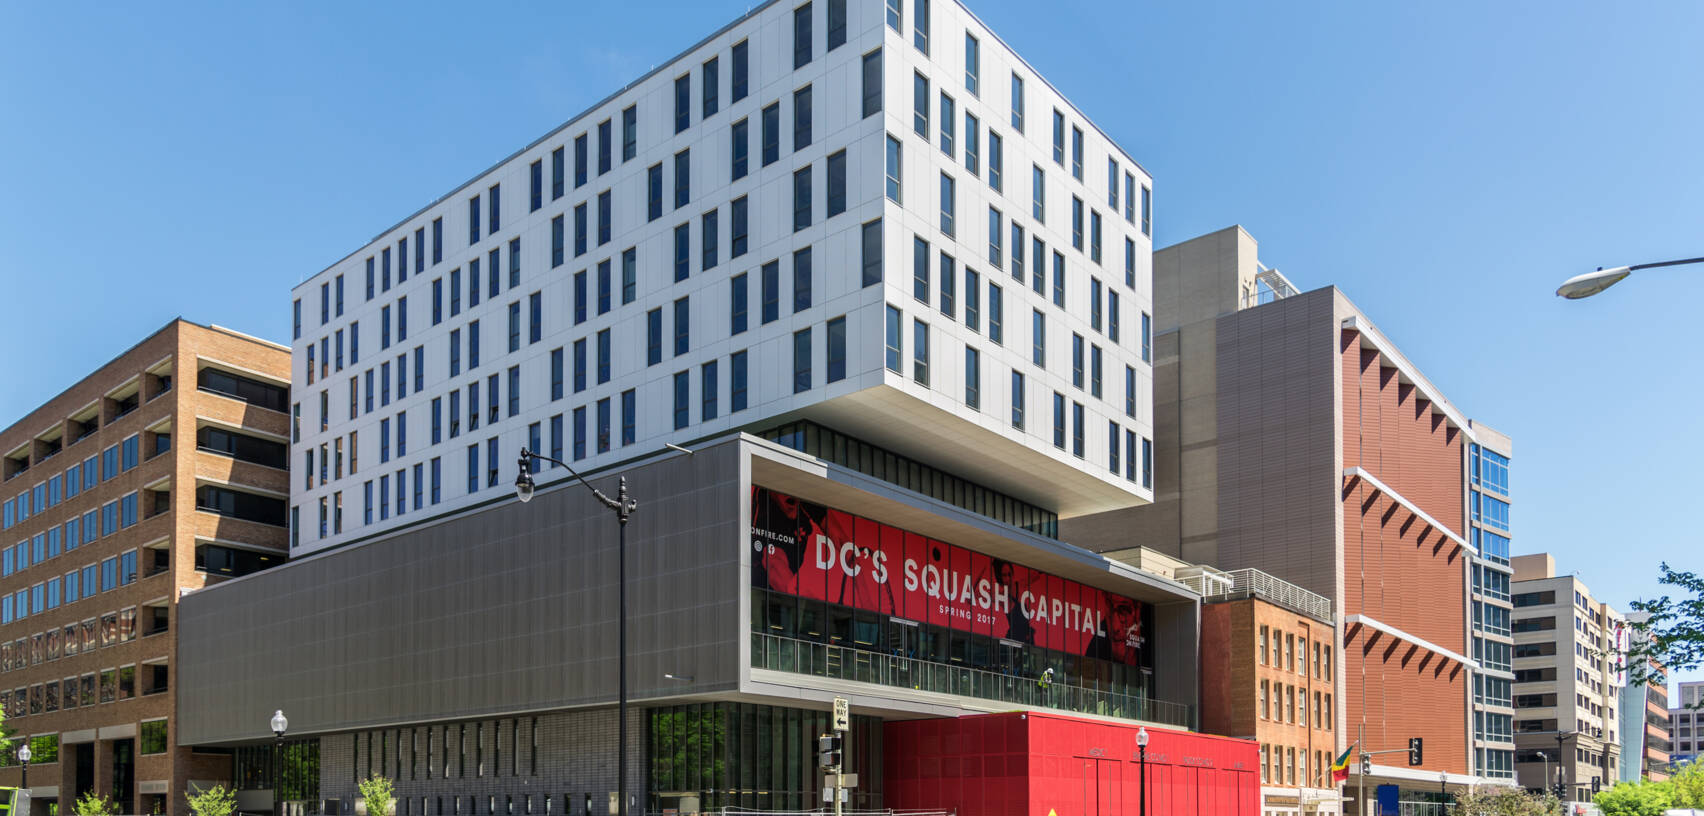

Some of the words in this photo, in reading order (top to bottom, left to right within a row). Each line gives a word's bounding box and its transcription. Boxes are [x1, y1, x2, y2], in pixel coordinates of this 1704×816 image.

[904, 558, 1009, 614] SQUASH
[1020, 590, 1106, 637] CAPITAL
[939, 604, 971, 619] SPRING
[977, 613, 996, 625] 2017
[836, 699, 847, 708] ONE
[836, 708, 847, 716] WAY
